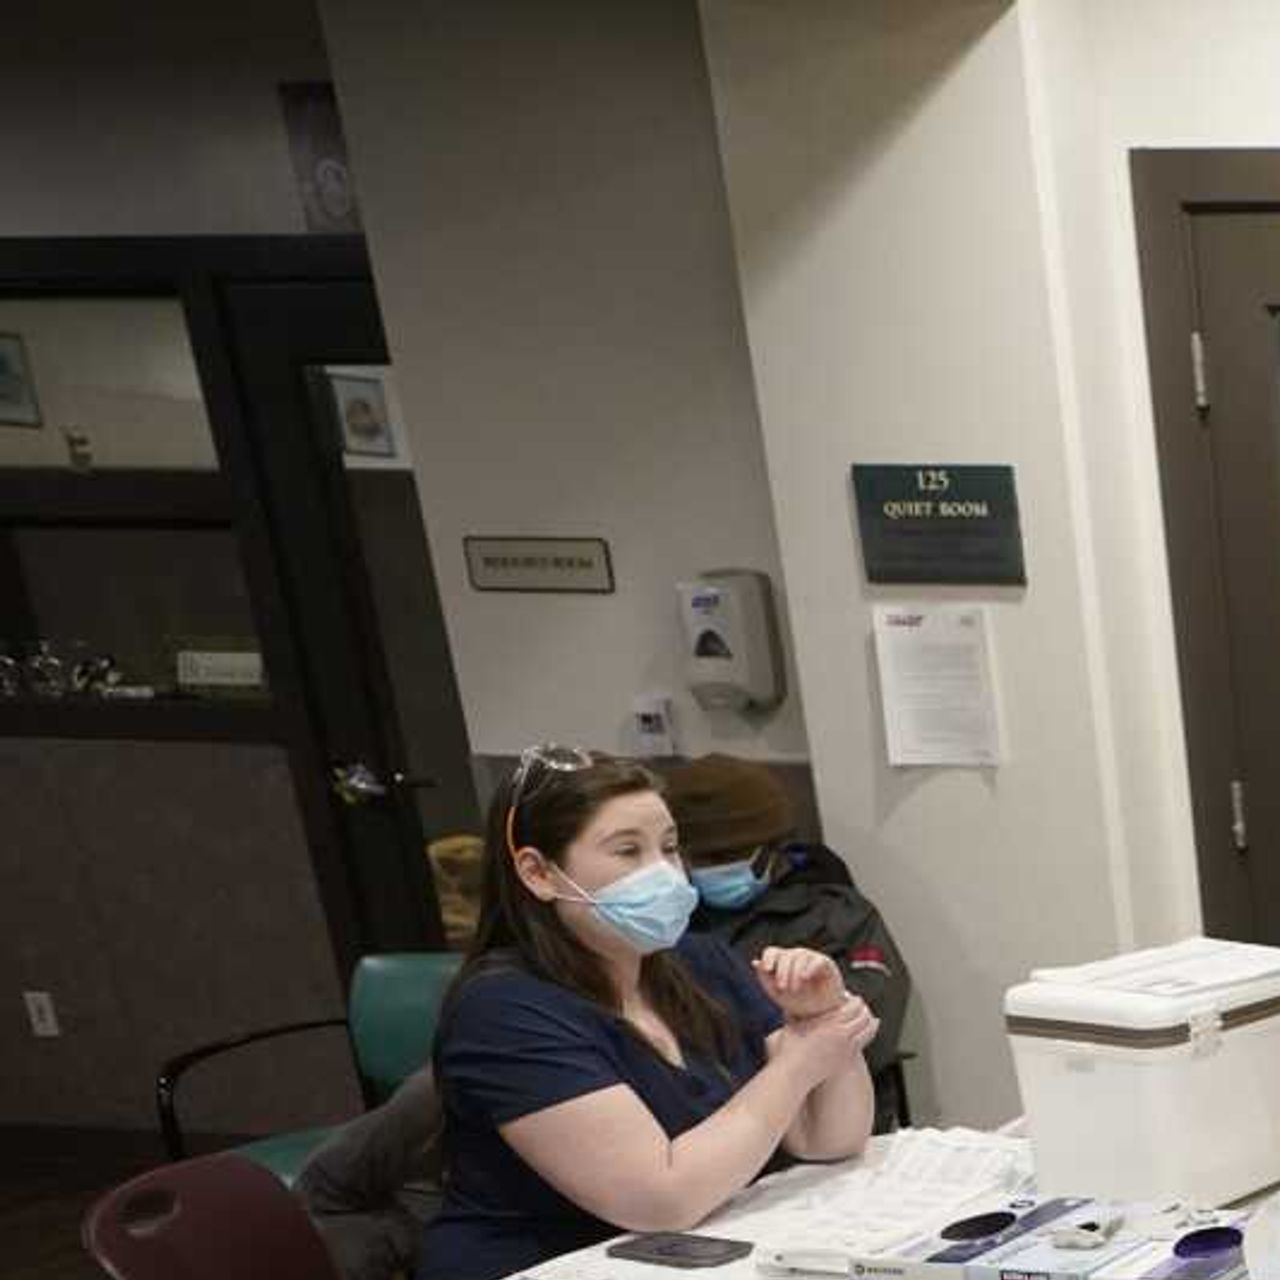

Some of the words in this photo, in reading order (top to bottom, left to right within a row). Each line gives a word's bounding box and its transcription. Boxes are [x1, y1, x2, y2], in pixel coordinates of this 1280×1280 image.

[917, 470, 949, 490] 125
[883, 502, 932, 518] QUIET
[939, 502, 988, 517] ROOM
